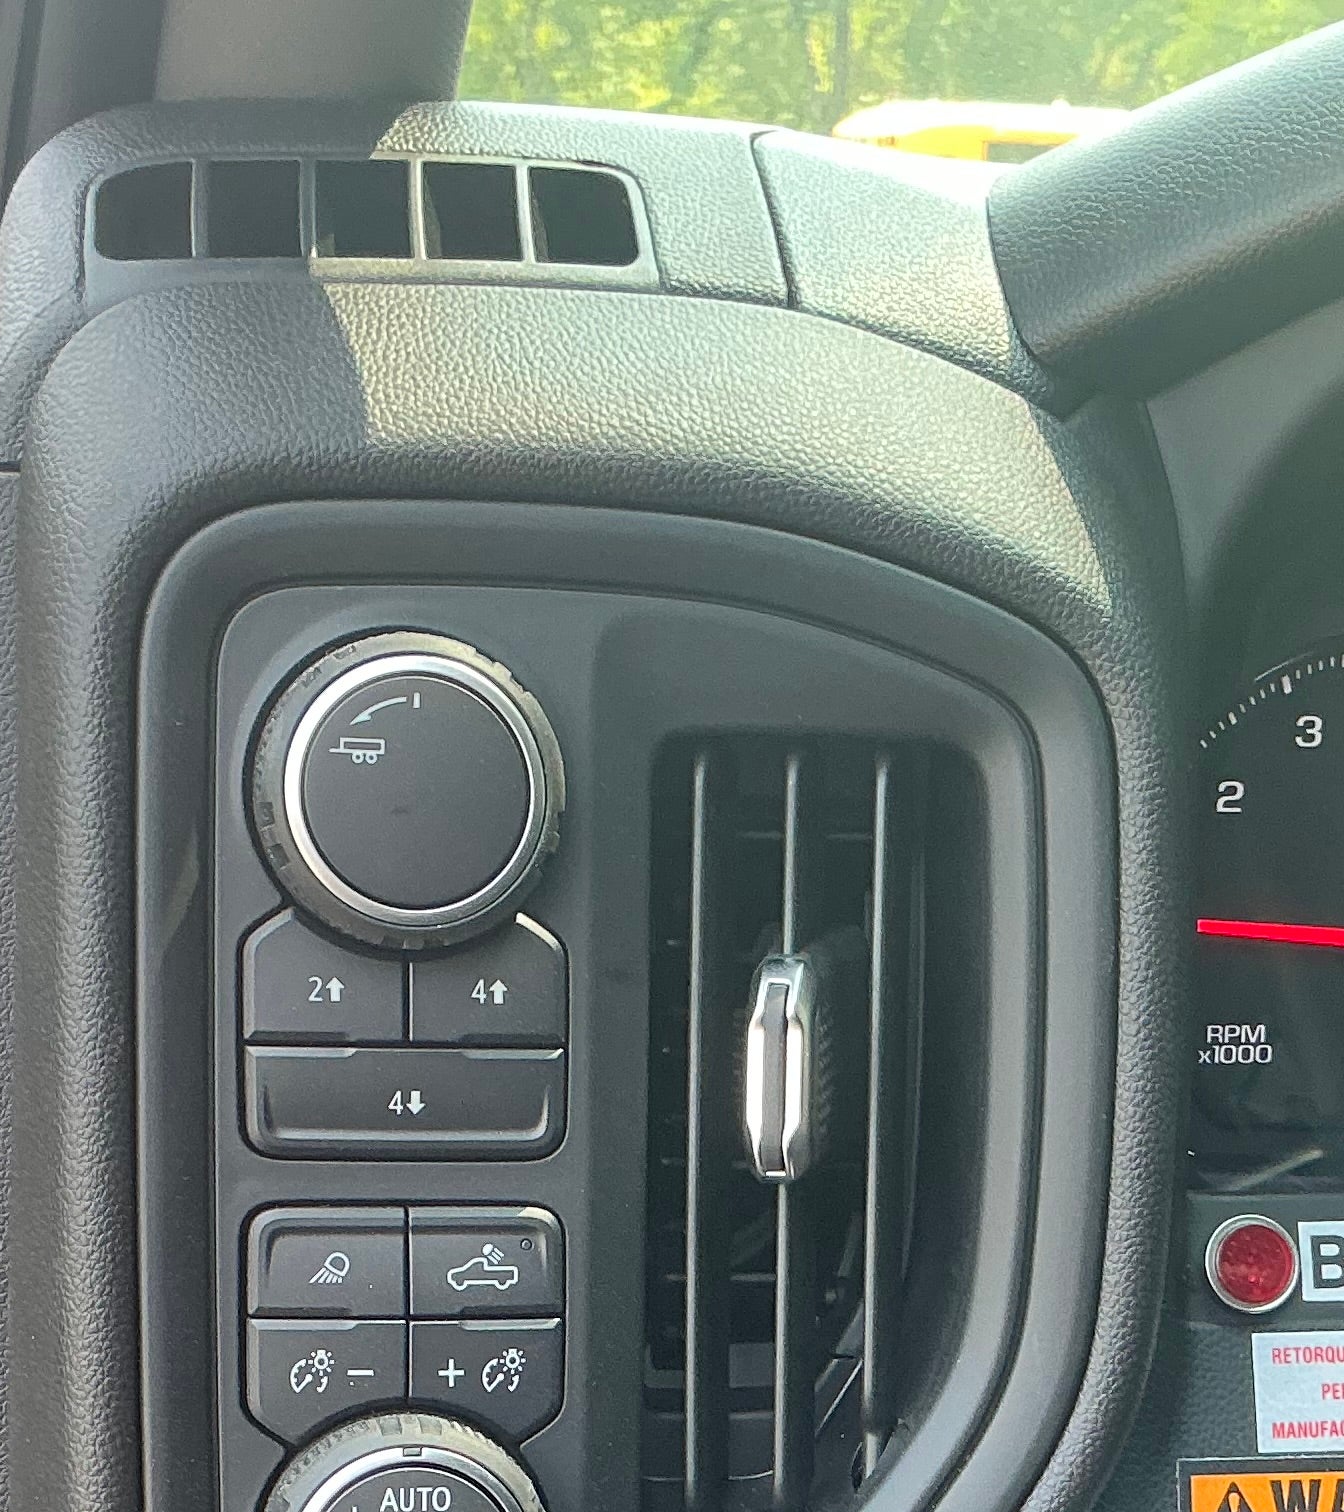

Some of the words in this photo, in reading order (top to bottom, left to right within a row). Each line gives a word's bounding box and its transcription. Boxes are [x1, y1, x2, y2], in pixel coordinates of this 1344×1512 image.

[1295, 715, 1323, 748] 3
[1215, 781, 1246, 814] 2
[307, 976, 323, 1003] 2
[471, 978, 487, 1004] 4
[1206, 1024, 1267, 1044] RPM
[1198, 1044, 1273, 1064] x1000
[387, 1090, 404, 1115] 4
[380, 1486, 451, 1512] AUTO
